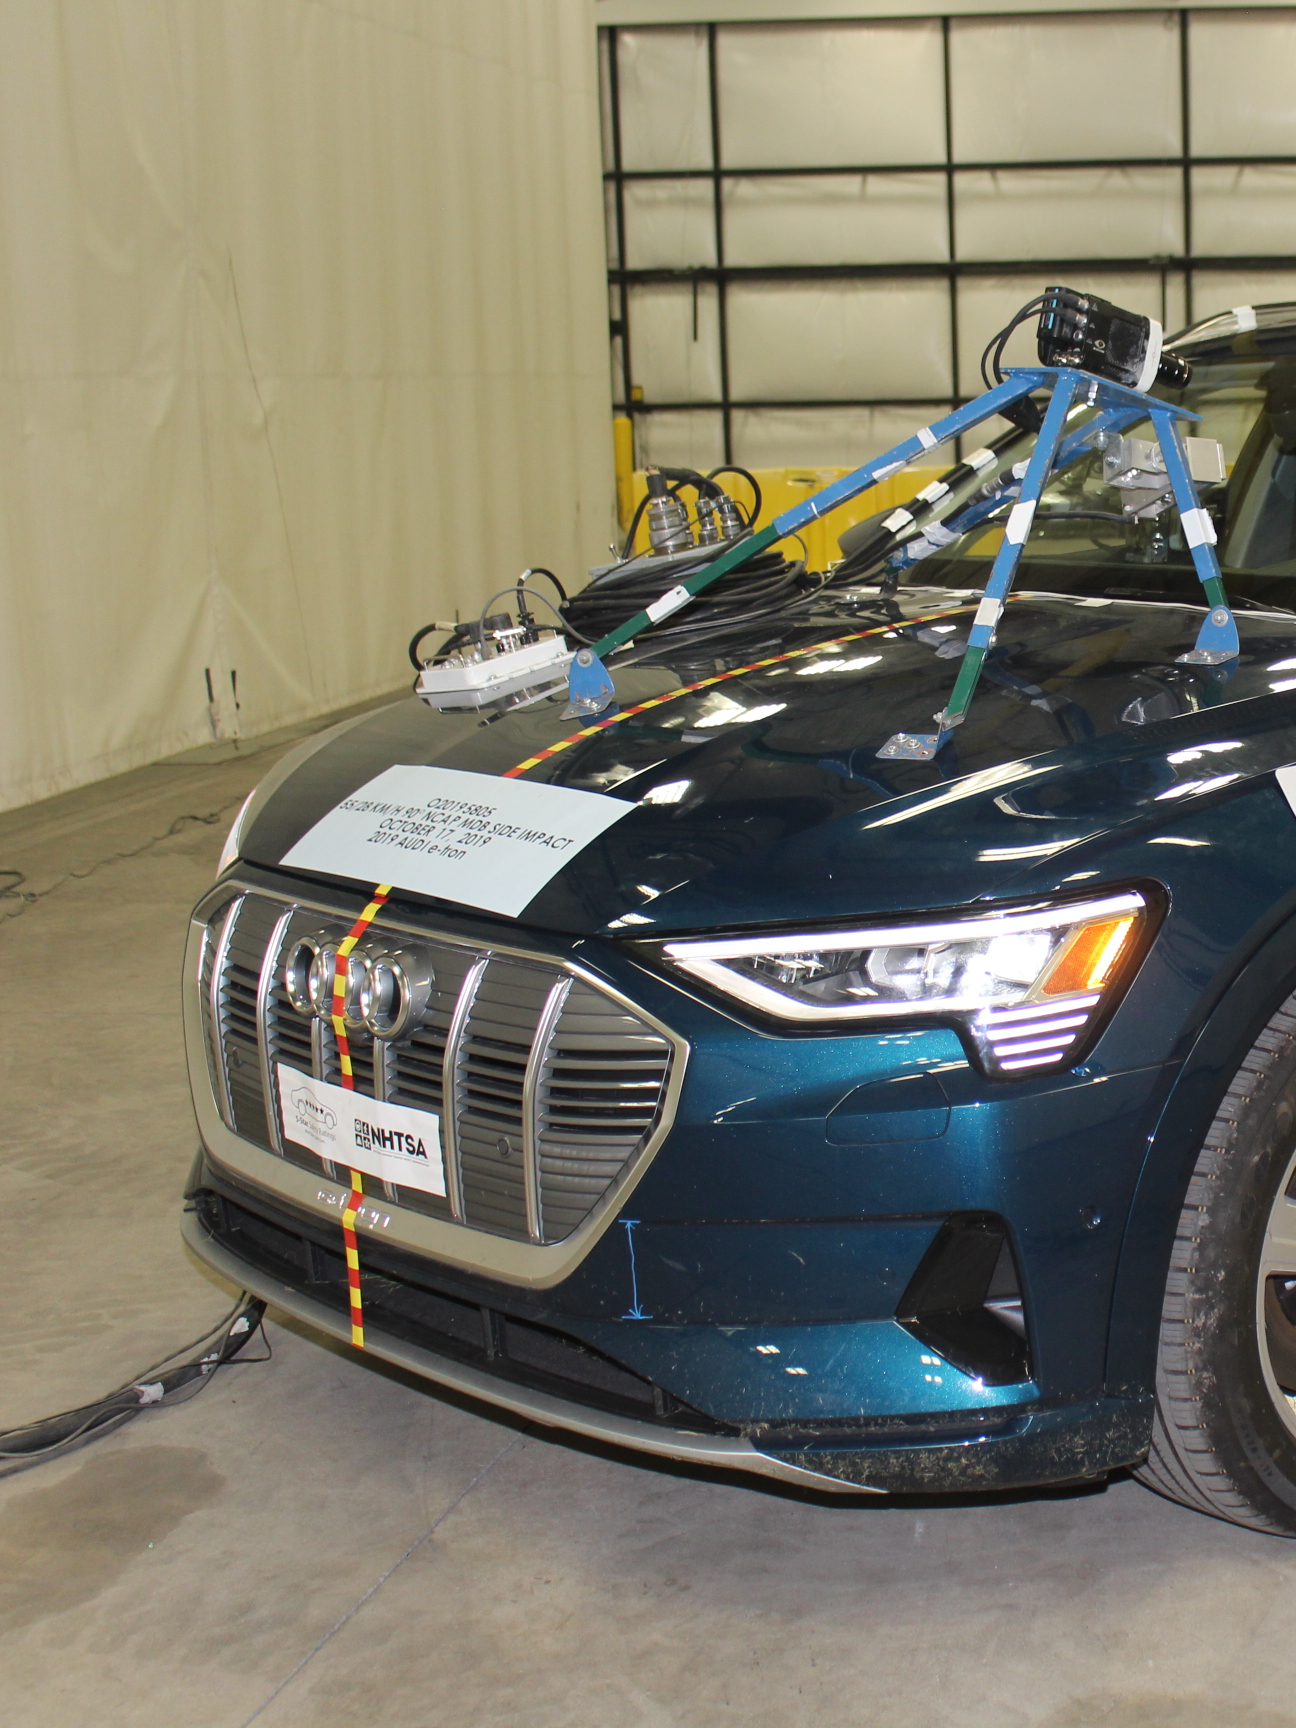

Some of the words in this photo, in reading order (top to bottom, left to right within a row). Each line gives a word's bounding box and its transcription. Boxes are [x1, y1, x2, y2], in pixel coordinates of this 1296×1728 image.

[339, 799, 374, 812] 55/28
[369, 802, 405, 816] KM/H
[420, 810, 461, 826] NCAP
[458, 817, 491, 832] MDB
[488, 823, 521, 838] SIDE
[516, 829, 575, 850] IMPACT
[379, 818, 436, 837] OCTOBER
[435, 828, 456, 843] 17,
[456, 832, 492, 848] 2019
[367, 831, 399, 846] 2019
[394, 836, 431, 852] AUDI
[427, 844, 467, 861] e-tron
[370, 1124, 428, 1160] NHTSA
